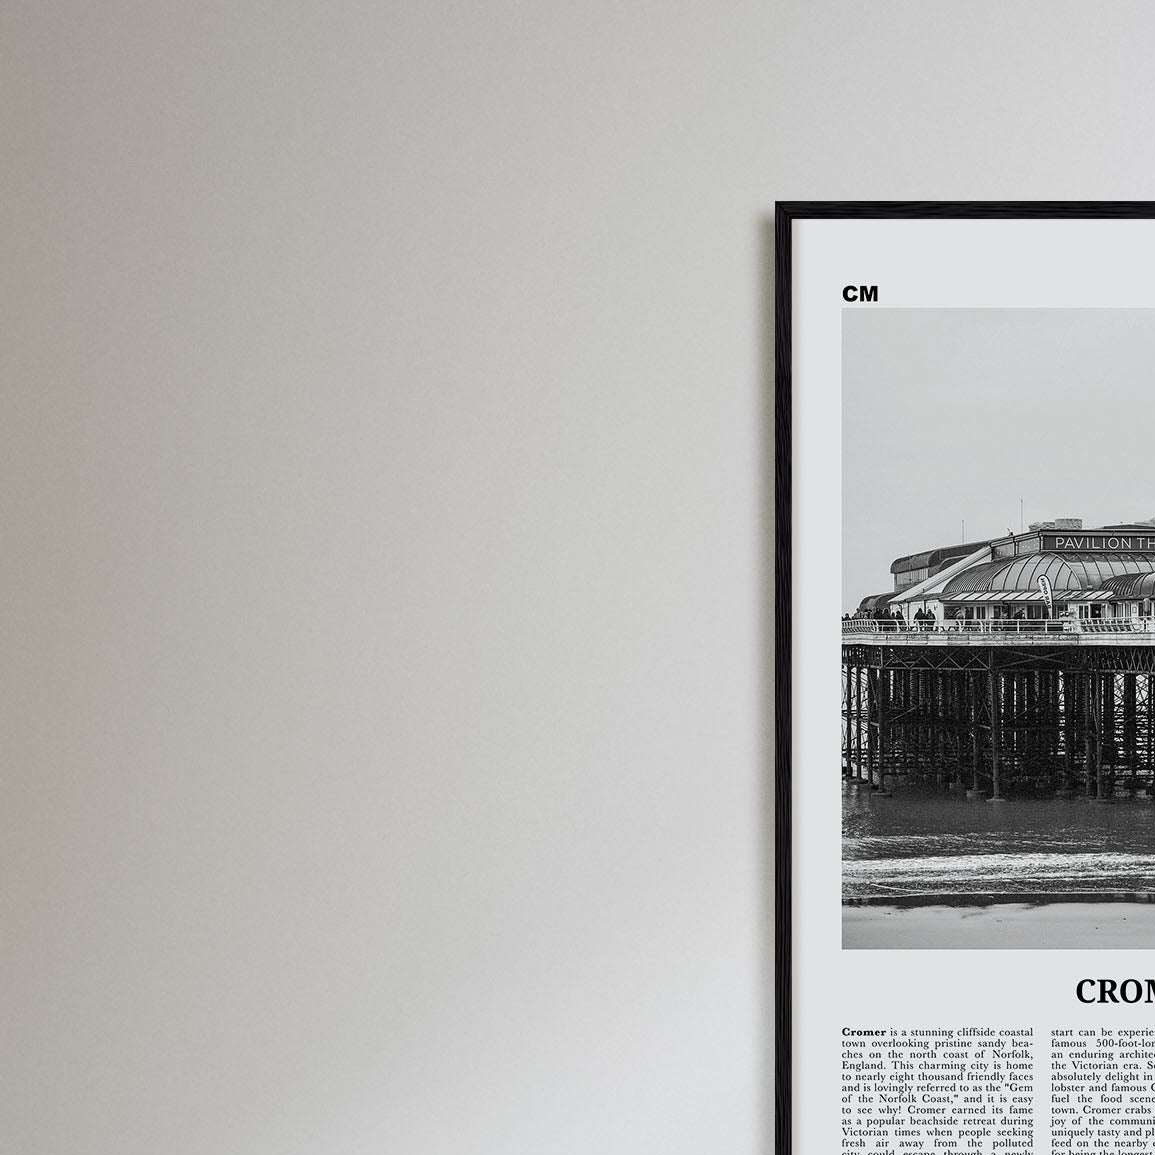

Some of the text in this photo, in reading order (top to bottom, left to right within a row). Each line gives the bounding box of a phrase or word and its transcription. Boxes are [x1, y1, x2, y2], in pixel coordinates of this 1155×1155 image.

[842, 284, 879, 303] CM
[1055, 537, 1132, 550] PAVILION
[841, 1028, 887, 1036] Cromer
[890, 1028, 898, 1036] is
[910, 1028, 954, 1039] stunning
[956, 1028, 996, 1036] cliffside
[998, 1028, 1033, 1036] coastal
[1101, 1028, 1113, 1036] be
[871, 1039, 930, 1050] overlooking
[934, 1039, 973, 1050] pristine
[977, 1039, 1007, 1050] sandy
[1011, 1039, 1033, 1047] bea-
[1051, 1039, 1087, 1047] famous
[842, 1061, 1034, 1072] England. This charming city is home
[1051, 1061, 1067, 1070] the
[1073, 1061, 1119, 1070] Victorian
[841, 1072, 1034, 1083] to nearly eight thousand friendly faces
[1051, 1072, 1102, 1083] absolutely
[1104, 1072, 1140, 1083] delight
[1143, 1072, 1153, 1081] in
[841, 1083, 860, 1092] and
[863, 1083, 872, 1092] is
[874, 1083, 914, 1094] lovingly
[916, 1083, 956, 1092] referred
[959, 1084, 970, 1092] to
[985, 1083, 1002, 1092] the
[1004, 1083, 1033, 1092] "Gem
[1051, 1083, 1086, 1092] lobster
[1088, 1083, 1108, 1092] and
[1111, 1083, 1147, 1092] famous
[842, 1127, 1034, 1139] Victorian times when people seeking
[1051, 1127, 1095, 1139] uniquely
[1097, 1129, 1121, 1139] tasty
[1123, 1127, 1142, 1136] and
